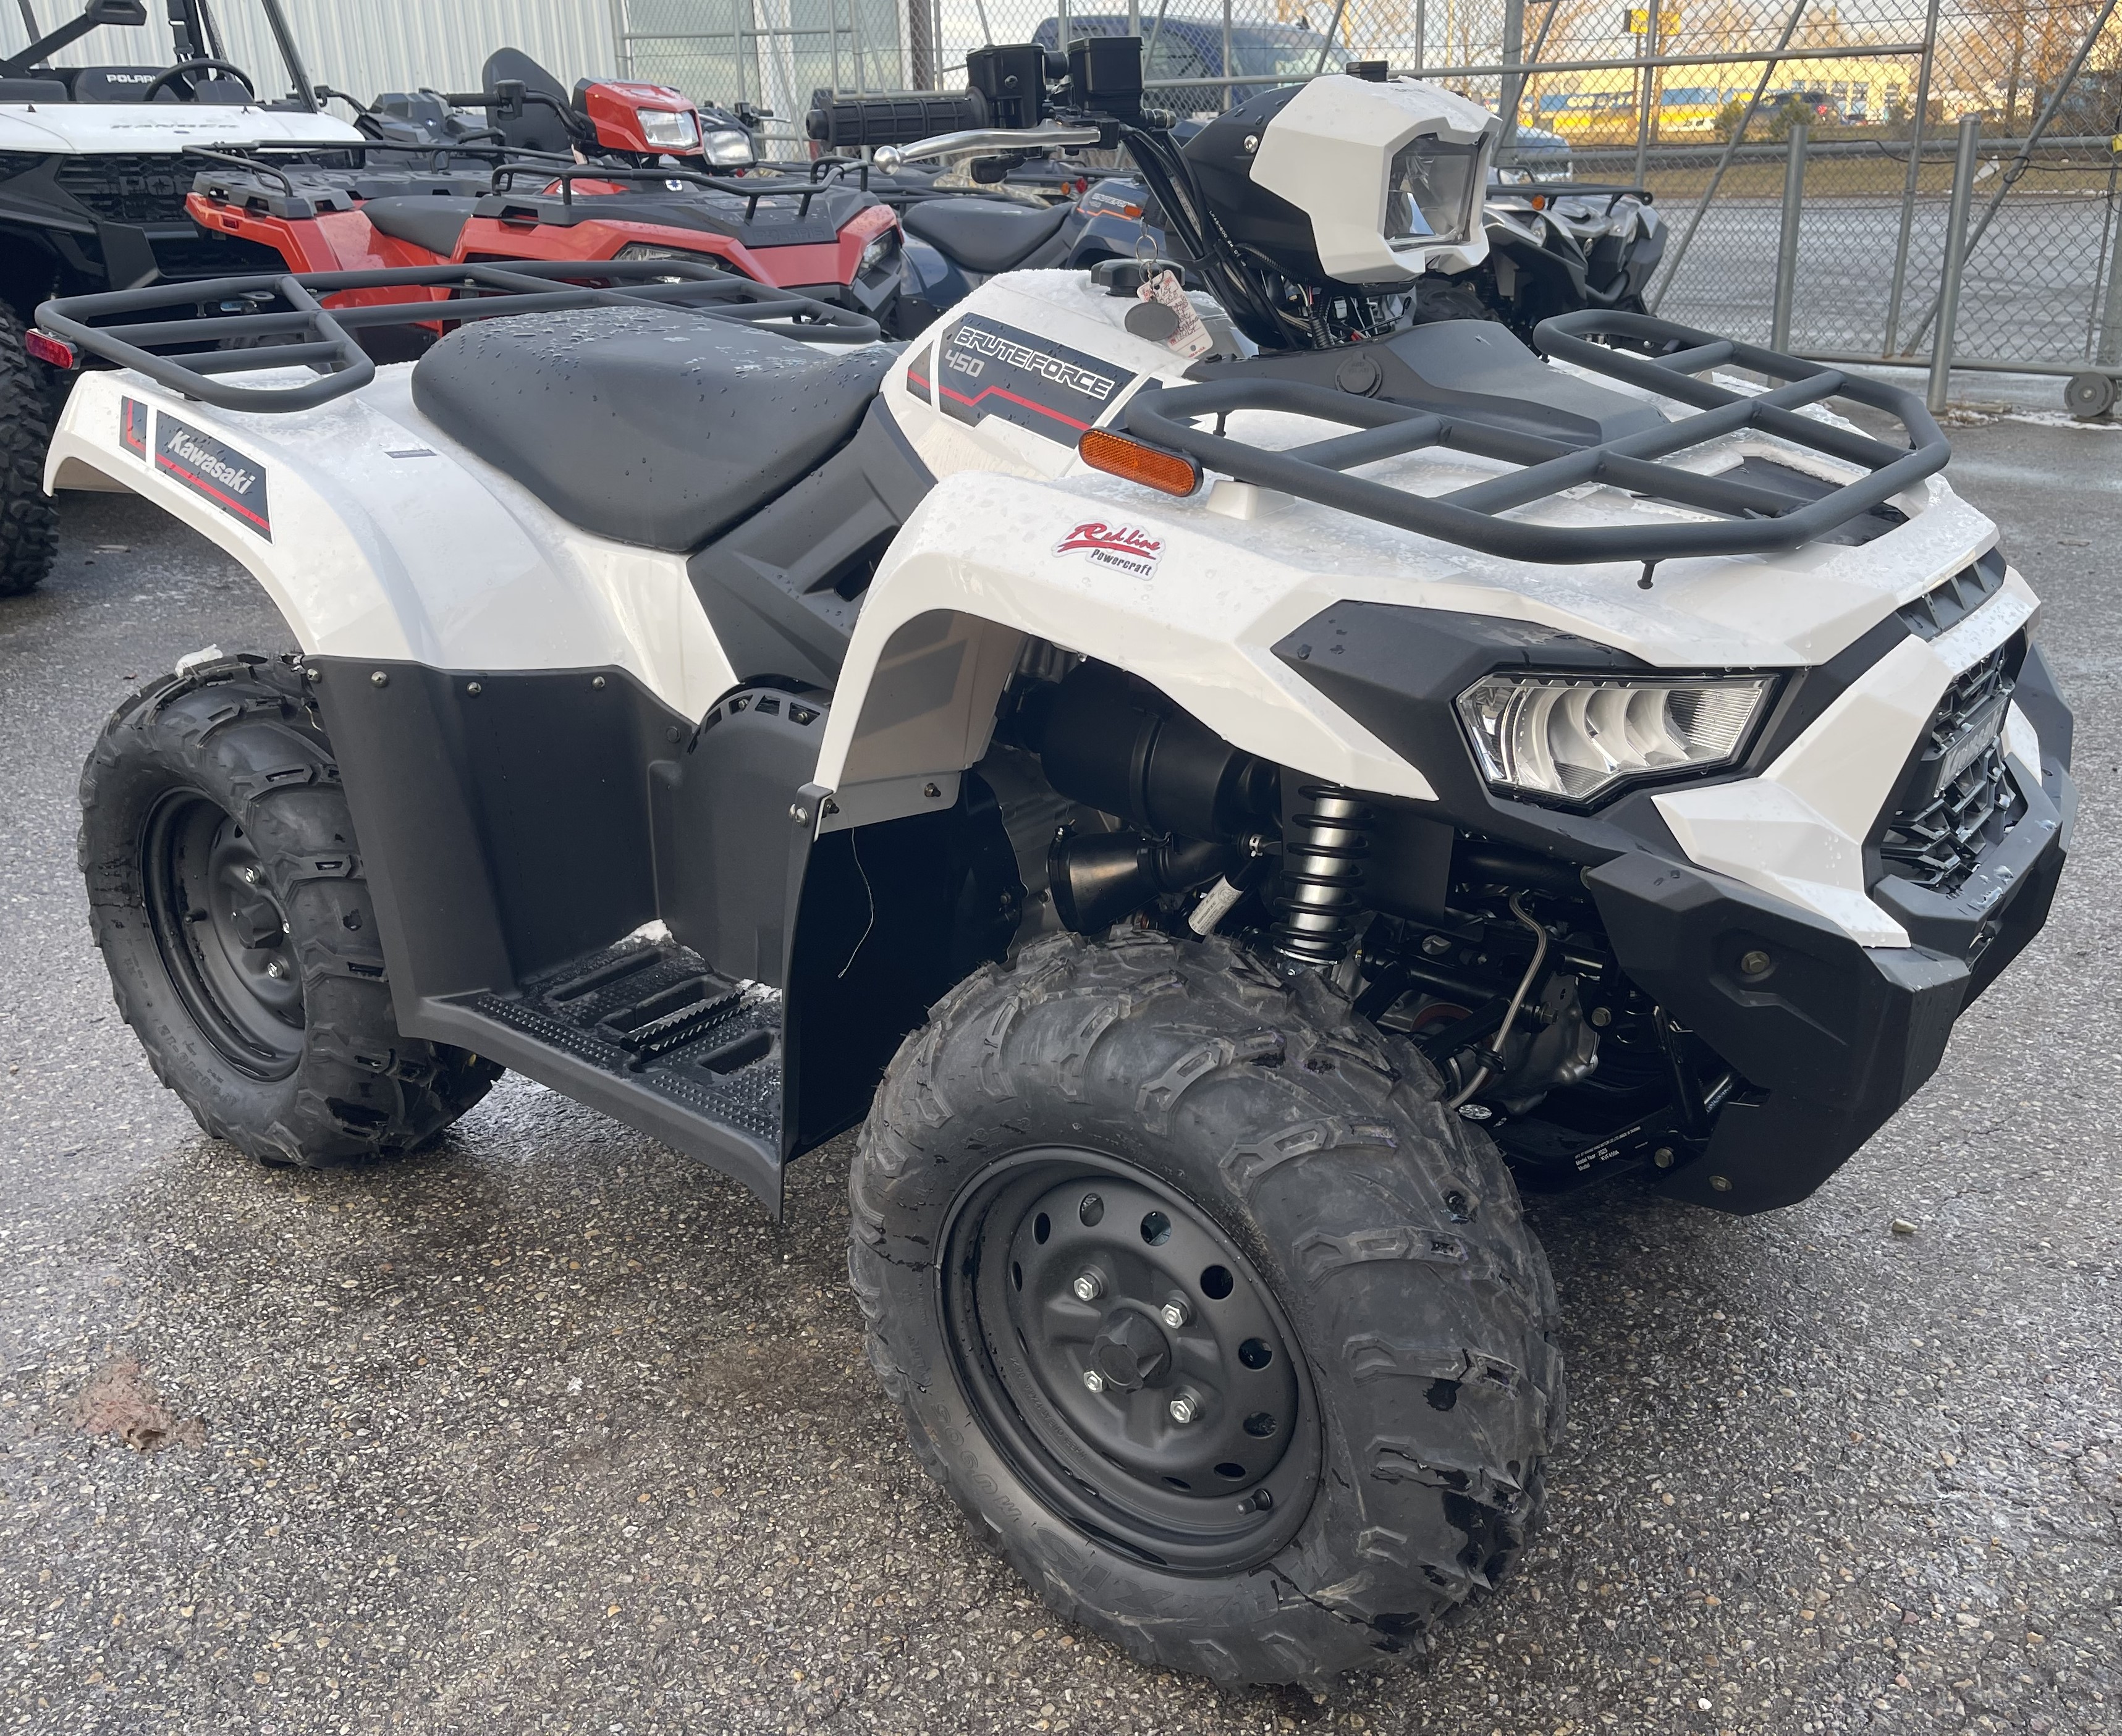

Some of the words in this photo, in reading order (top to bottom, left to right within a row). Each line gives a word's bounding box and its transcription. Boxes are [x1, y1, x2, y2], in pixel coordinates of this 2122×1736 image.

[945, 349, 985, 377] 450
[167, 430, 256, 494] Kawasaki
[1090, 548, 1152, 576] Powercraft
